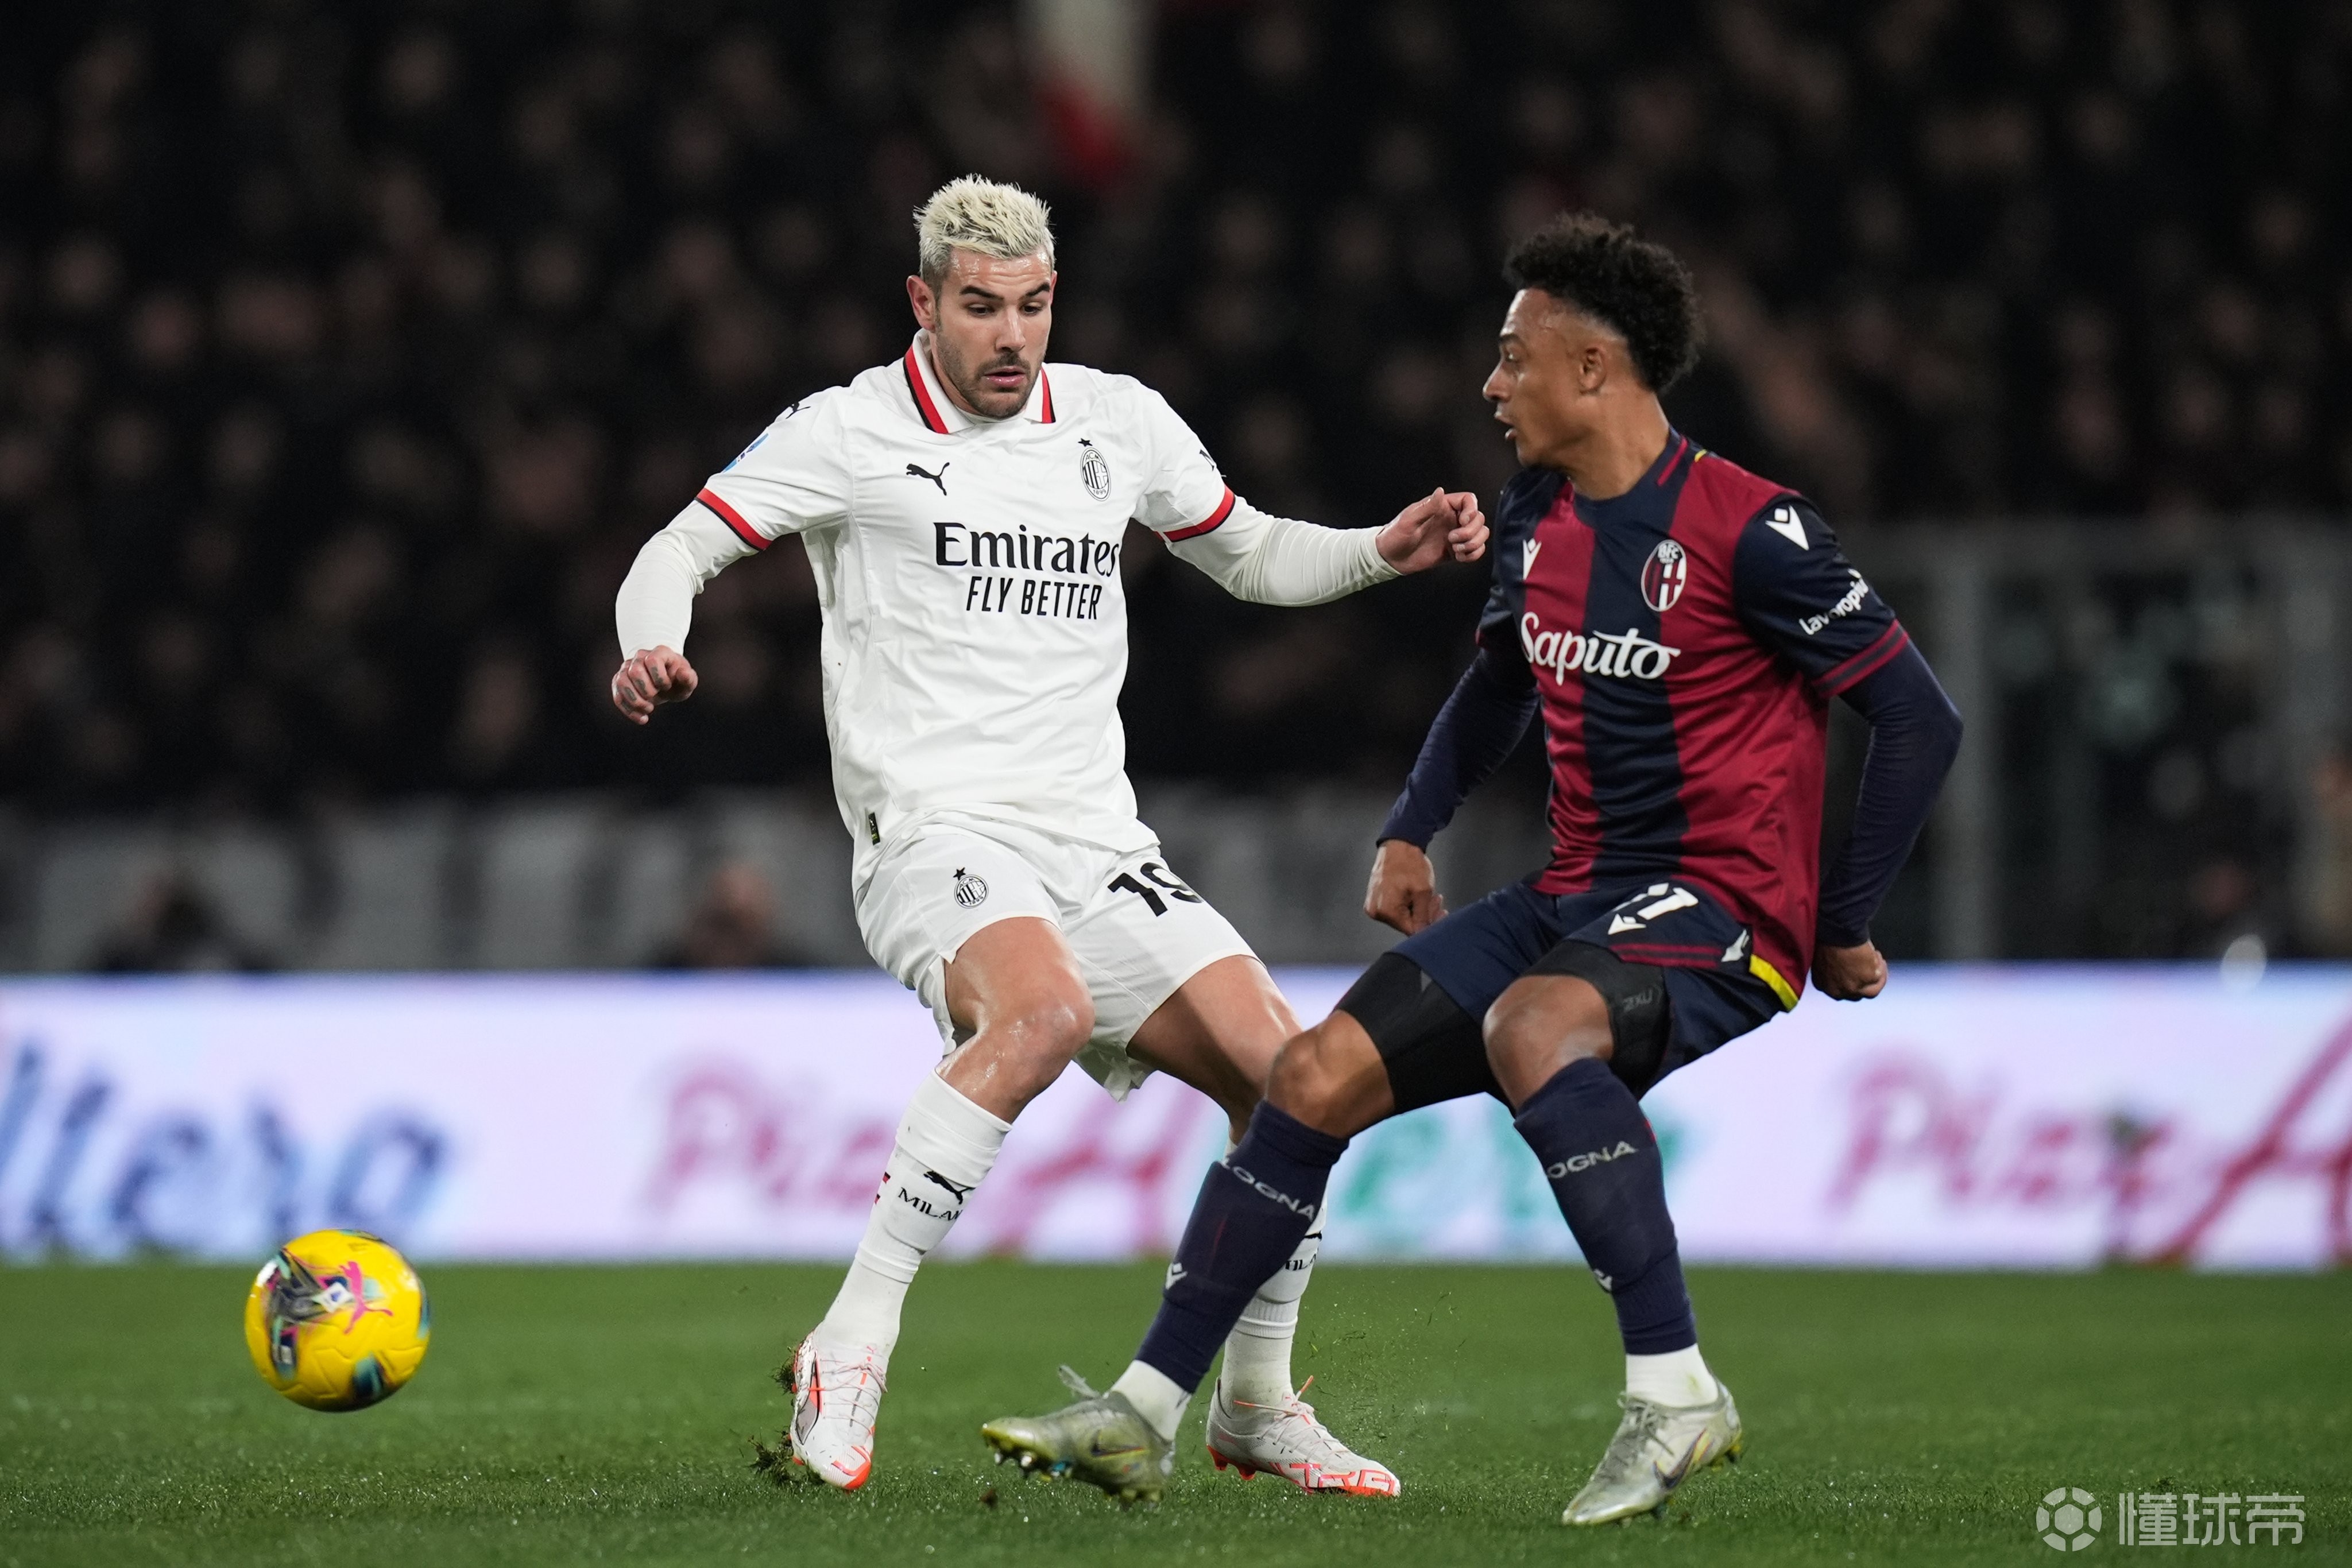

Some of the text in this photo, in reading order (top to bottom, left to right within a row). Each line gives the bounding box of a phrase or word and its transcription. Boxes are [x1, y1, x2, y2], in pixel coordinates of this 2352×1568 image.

[1085, 452, 1101, 463] ACM
[933, 522, 1119, 577] Emirates
[966, 576, 1102, 620] FLY BETTER
[1521, 611, 1681, 686] Saputo
[1107, 862, 1205, 917] 19
